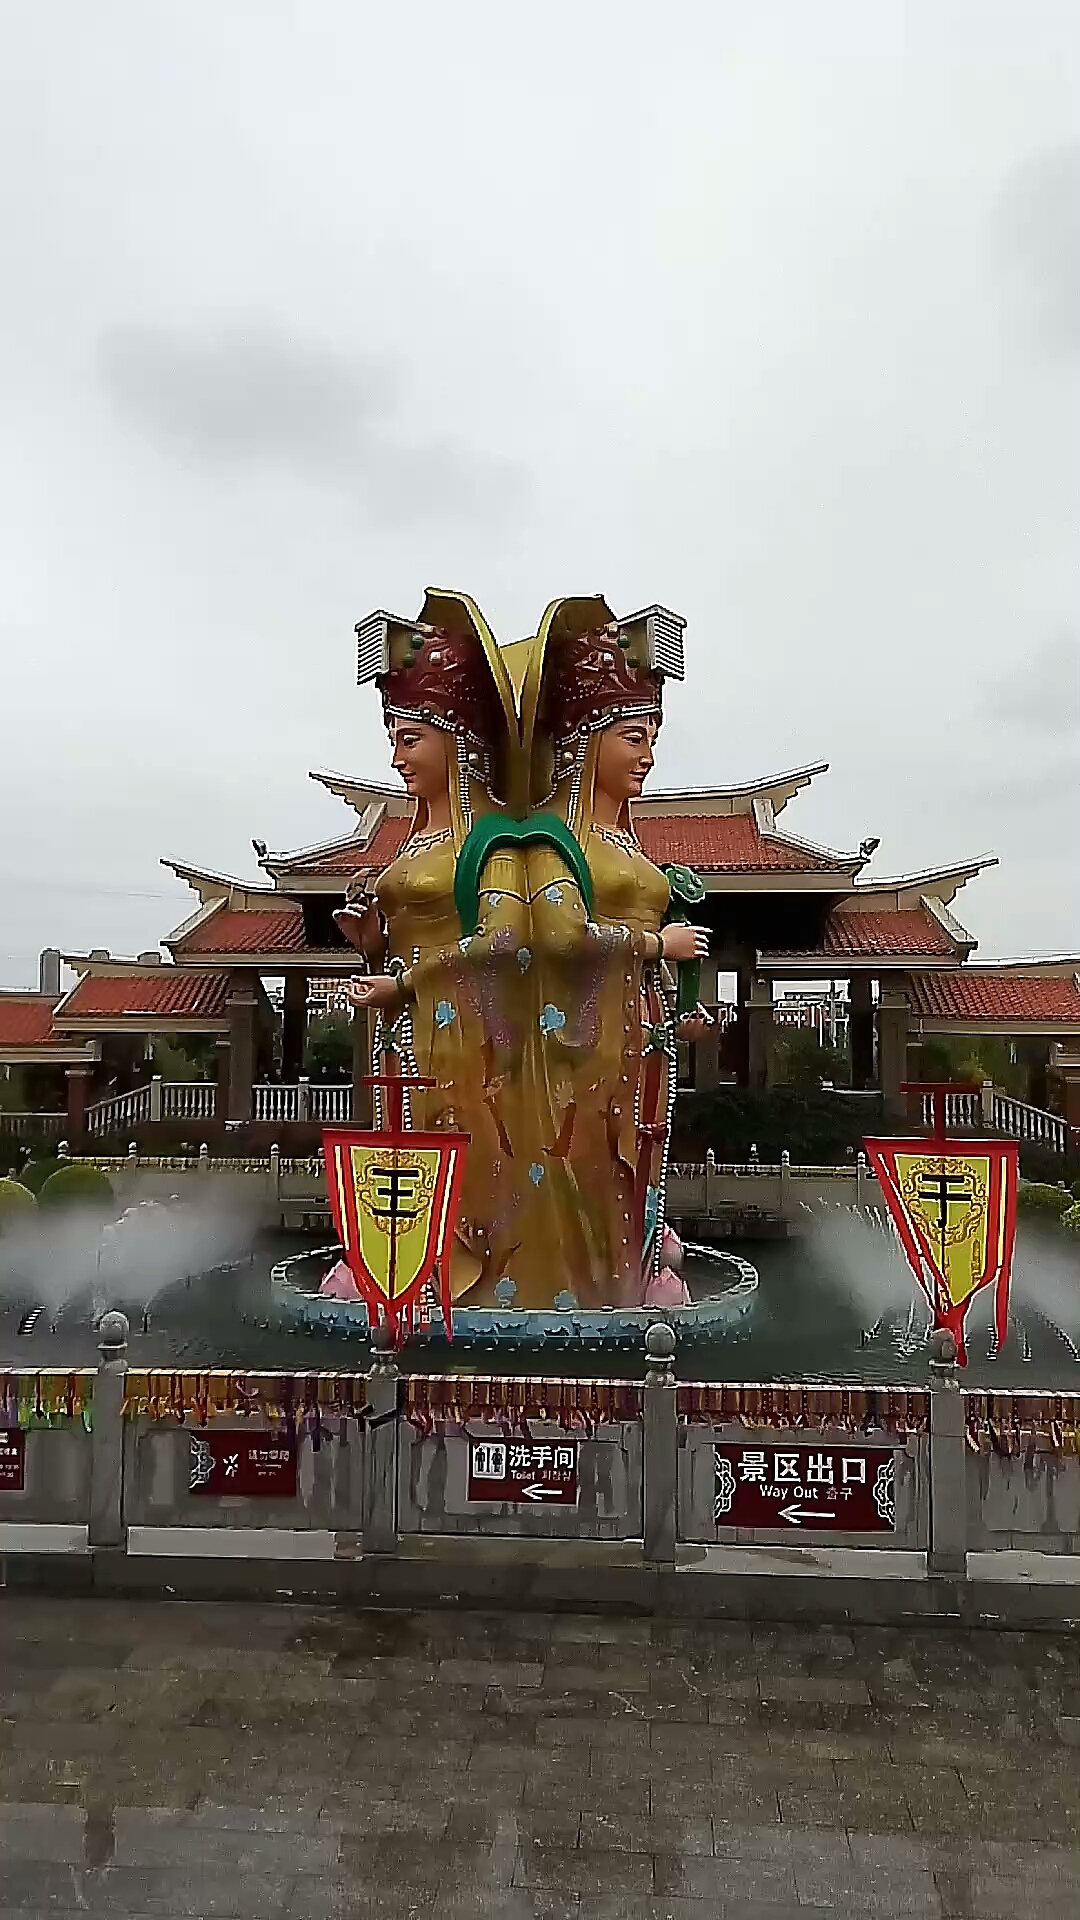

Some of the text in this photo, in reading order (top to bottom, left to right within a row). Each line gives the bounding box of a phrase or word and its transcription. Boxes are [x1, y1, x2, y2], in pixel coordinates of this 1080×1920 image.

[508, 1444, 574, 1469] 洗手间
[737, 1451, 866, 1485] 景区出口
[759, 1484, 788, 1500] Way
[793, 1485, 819, 1499] Out
